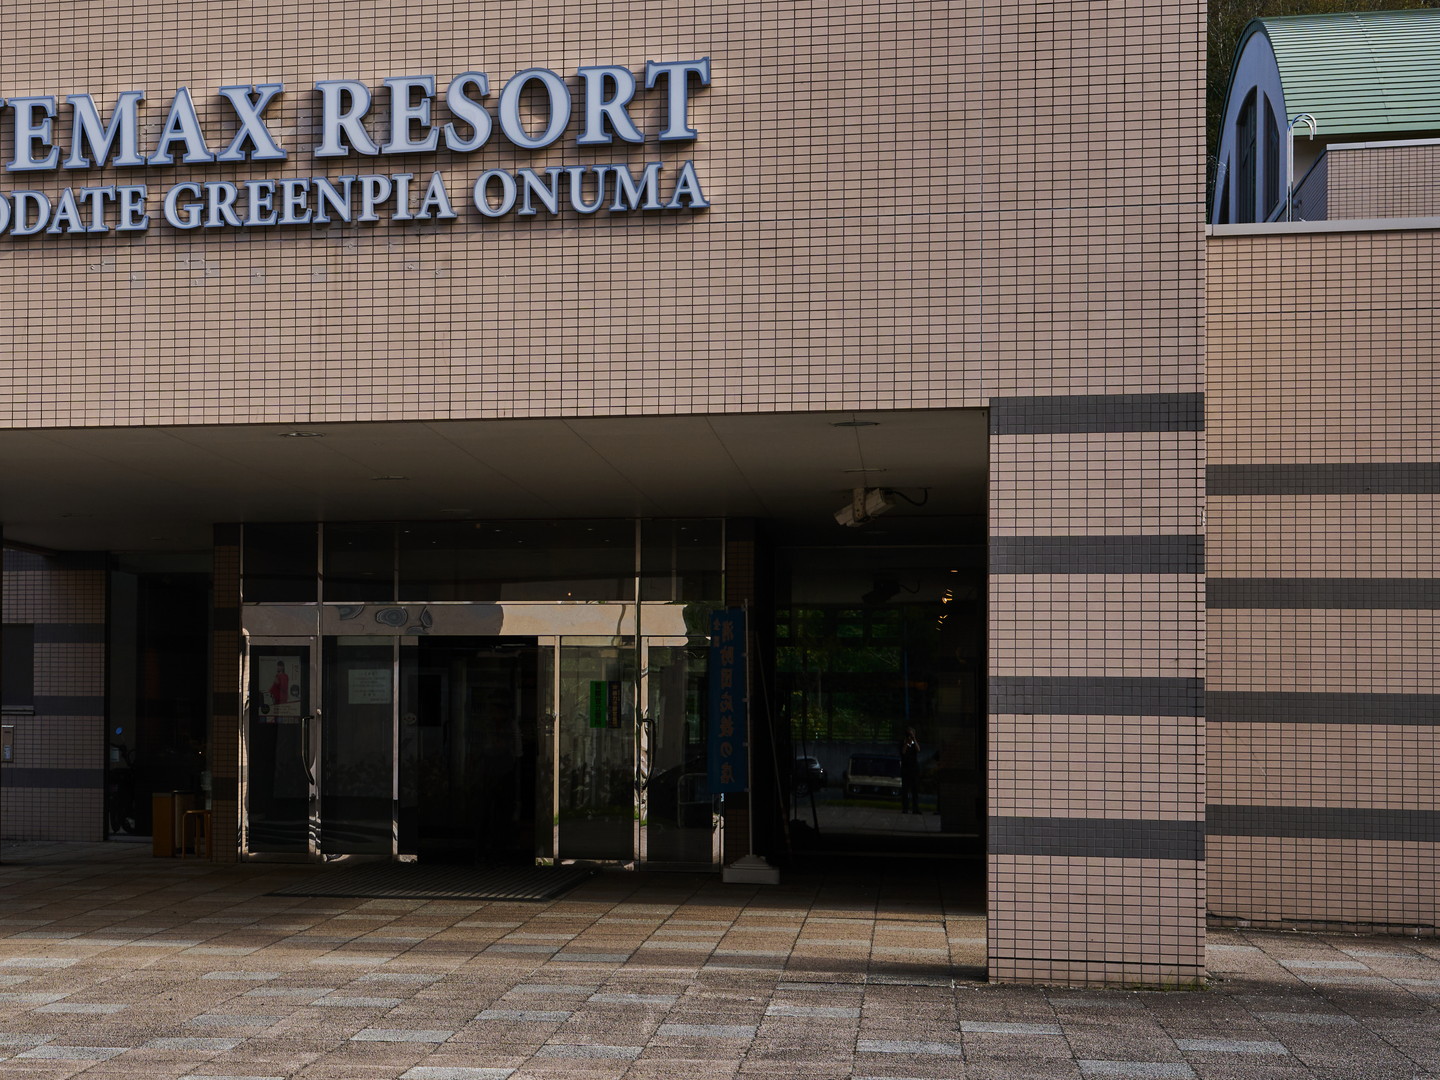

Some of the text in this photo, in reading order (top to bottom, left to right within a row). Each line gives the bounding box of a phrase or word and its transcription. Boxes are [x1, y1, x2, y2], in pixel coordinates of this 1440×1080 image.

[314, 56, 711, 157] RESORT
[163, 172, 458, 231] GREENPIA
[473, 159, 711, 218] ONUMA
